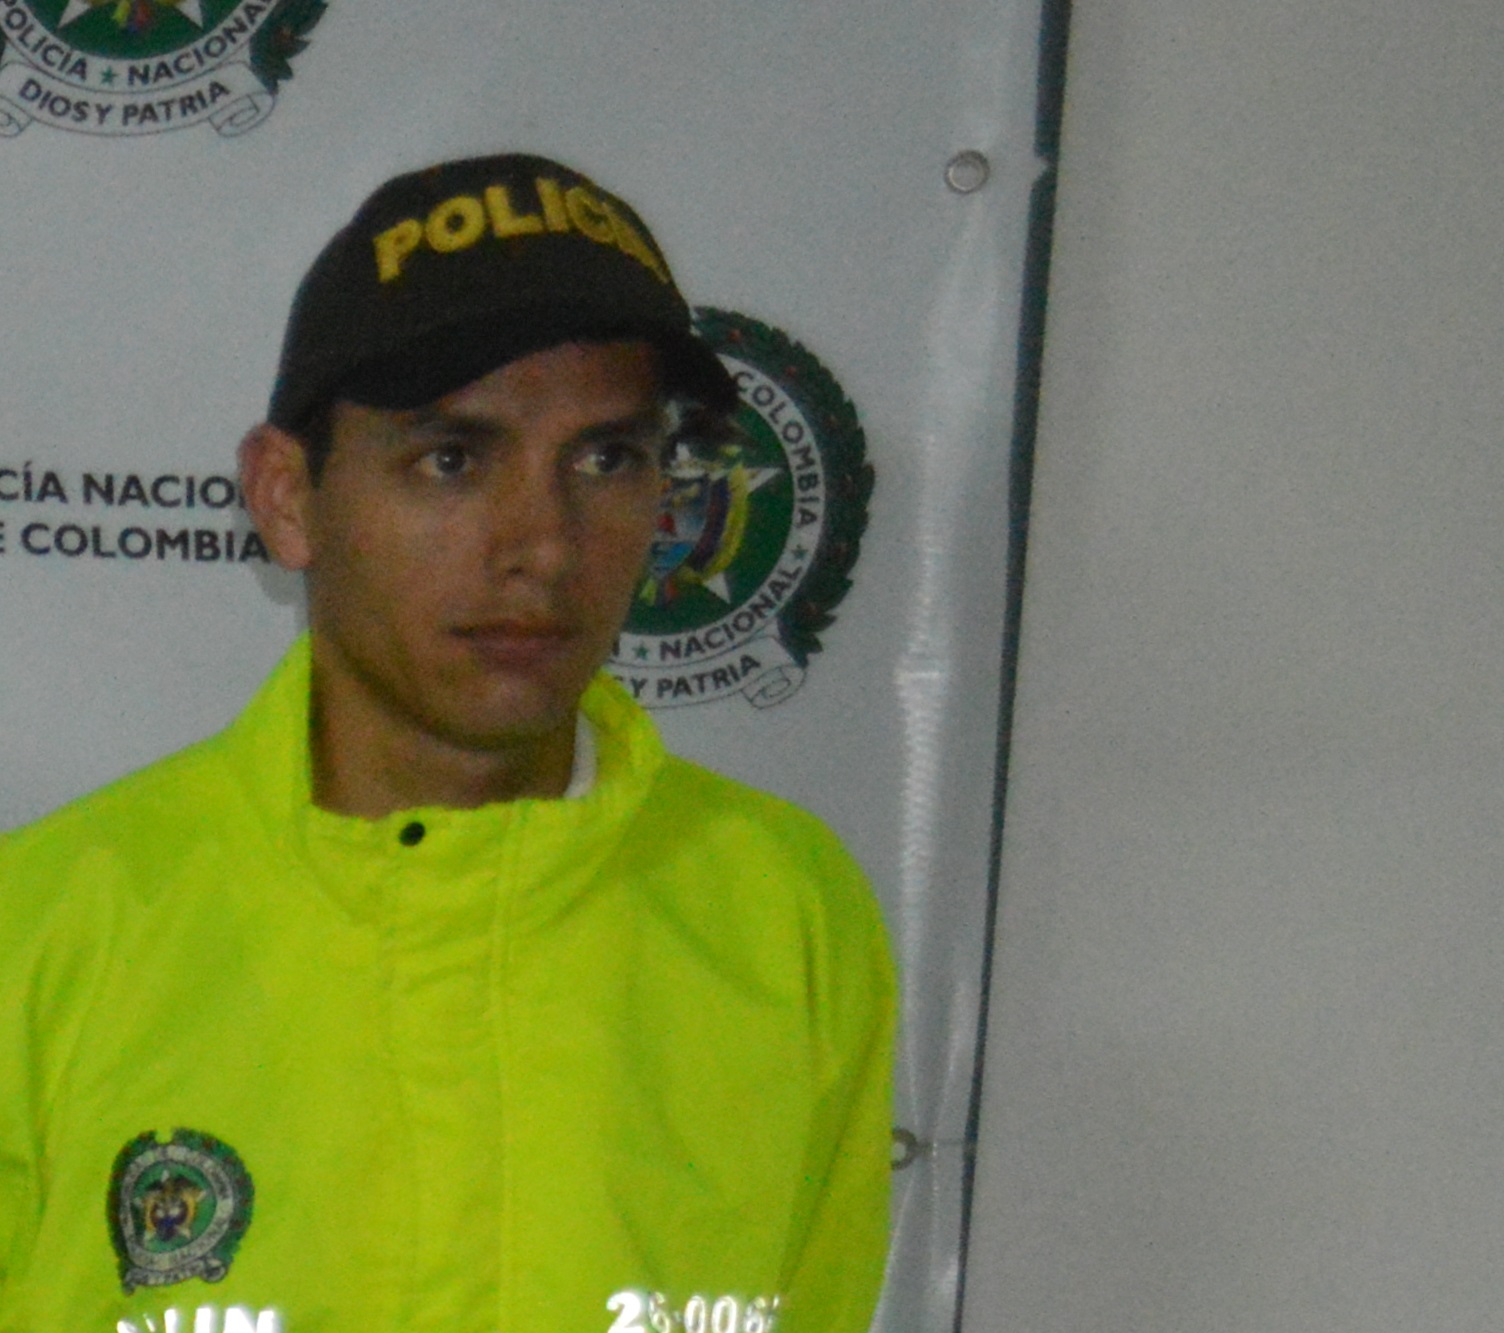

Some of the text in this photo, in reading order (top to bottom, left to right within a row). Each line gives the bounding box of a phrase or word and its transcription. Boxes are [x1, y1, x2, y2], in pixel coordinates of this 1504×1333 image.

[126, 0, 276, 86] NACIONA
[17, 78, 88, 124] DIOS
[121, 80, 230, 127] PATRIA
[733, 370, 821, 529] COLOMBIA
[82, 472, 246, 509] NACIO
[20, 522, 272, 564] COLOMBIA
[659, 564, 804, 661] NACIONAL
[657, 653, 761, 699] PATRIA
